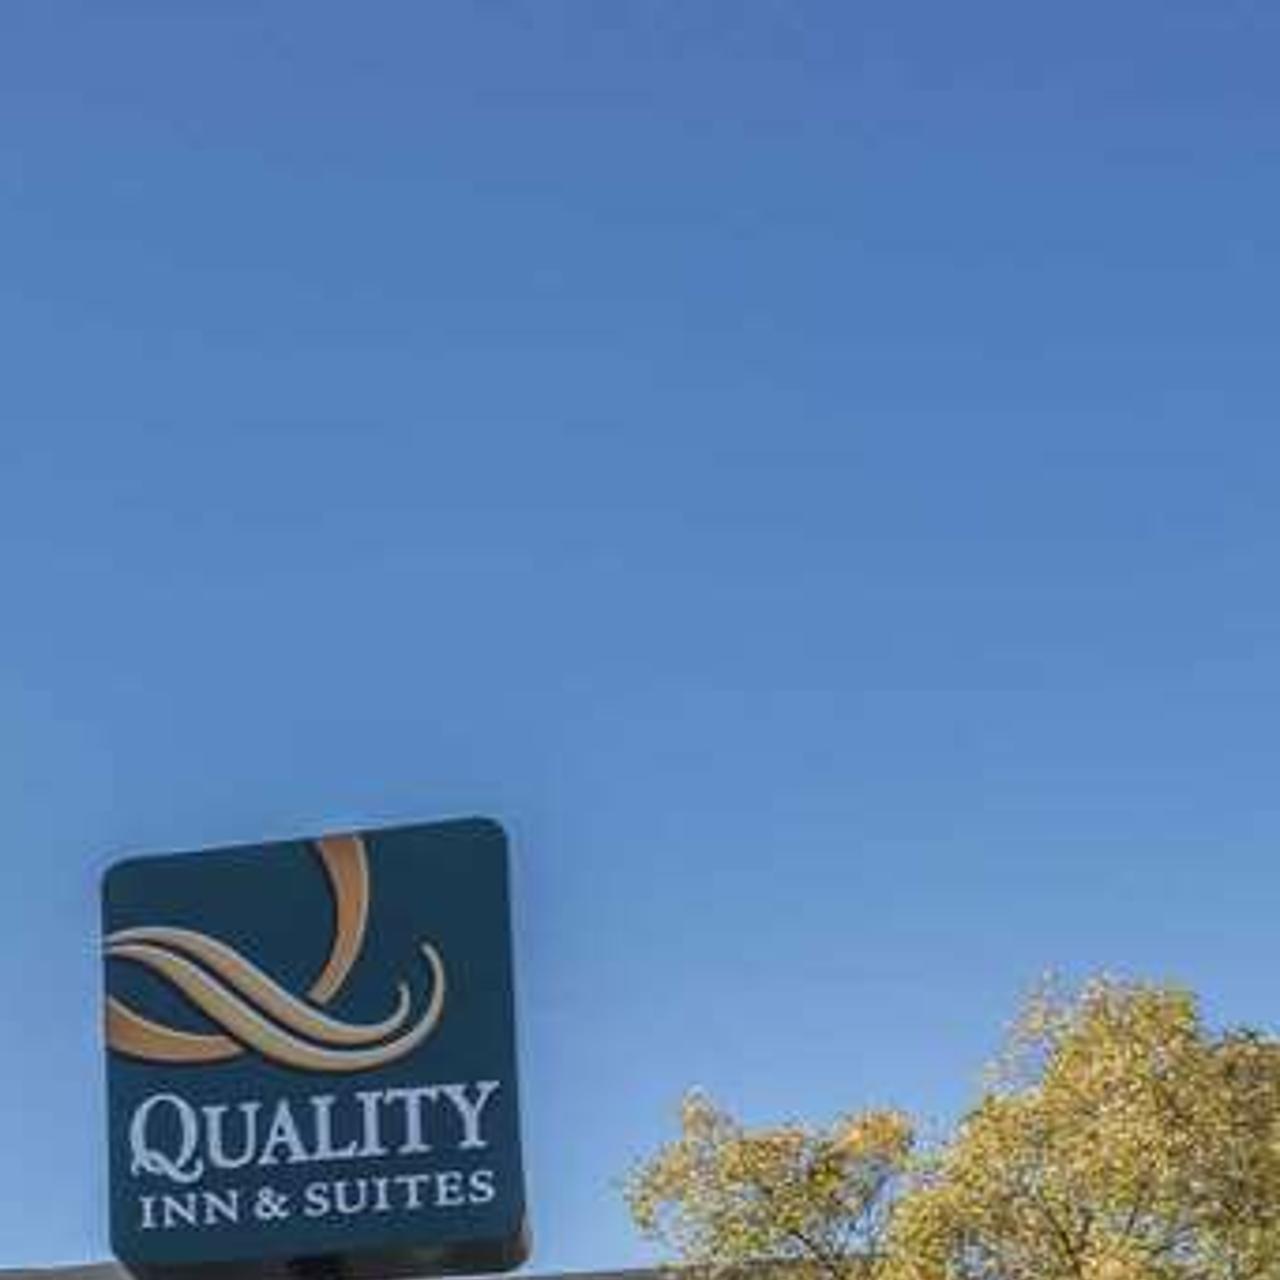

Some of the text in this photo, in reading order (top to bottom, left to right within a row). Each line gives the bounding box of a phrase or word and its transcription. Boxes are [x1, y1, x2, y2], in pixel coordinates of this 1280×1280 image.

[129, 1081, 500, 1183] QUALITY
[140, 1170, 496, 1229] INN & SUITES
